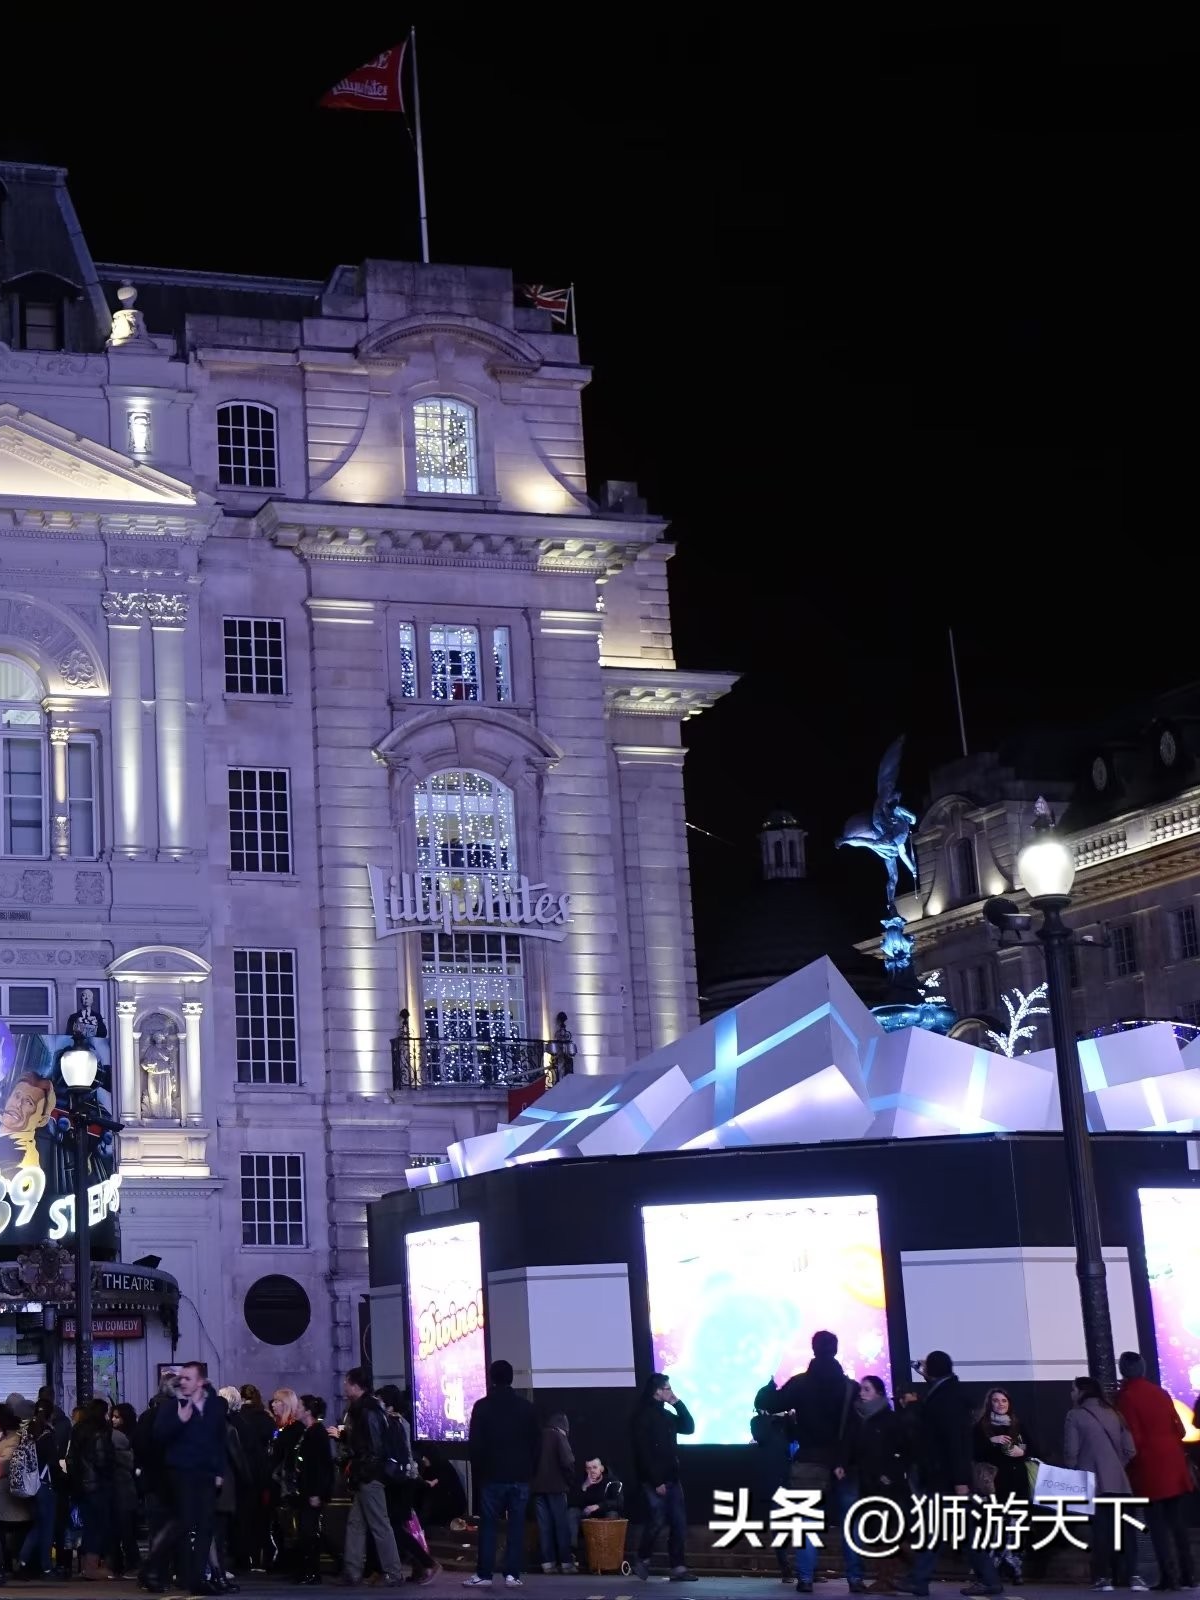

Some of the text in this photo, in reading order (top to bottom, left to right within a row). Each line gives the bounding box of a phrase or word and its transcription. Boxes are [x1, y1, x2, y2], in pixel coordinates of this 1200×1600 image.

[367, 863, 571, 942] Lillywhites
[102, 1273, 156, 1291] THEATRE
[106, 1320, 139, 1332] COMEDY
[416, 1290, 485, 1361] Divine!
[1042, 1479, 1087, 1494] TOPSHOP
